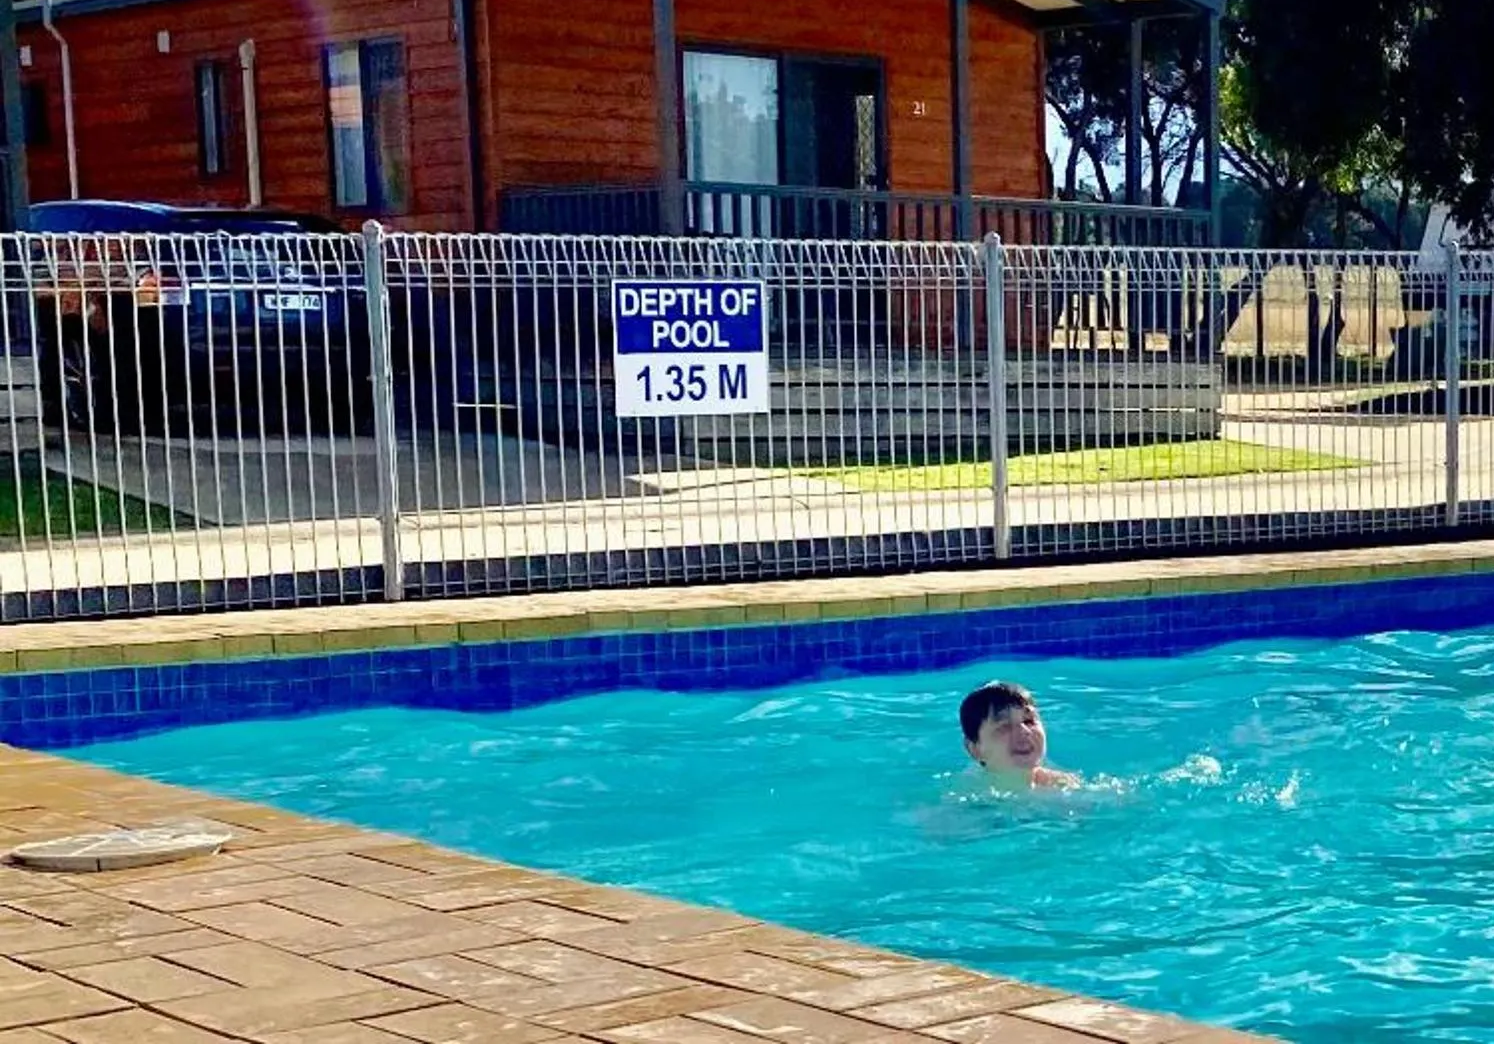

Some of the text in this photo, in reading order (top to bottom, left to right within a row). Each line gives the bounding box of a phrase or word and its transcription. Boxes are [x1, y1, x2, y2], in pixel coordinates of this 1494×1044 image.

[913, 101, 925, 116] 21
[619, 288, 757, 317] DEPTH OF
[652, 320, 730, 348] POOL
[636, 363, 748, 402] 1.35 M
